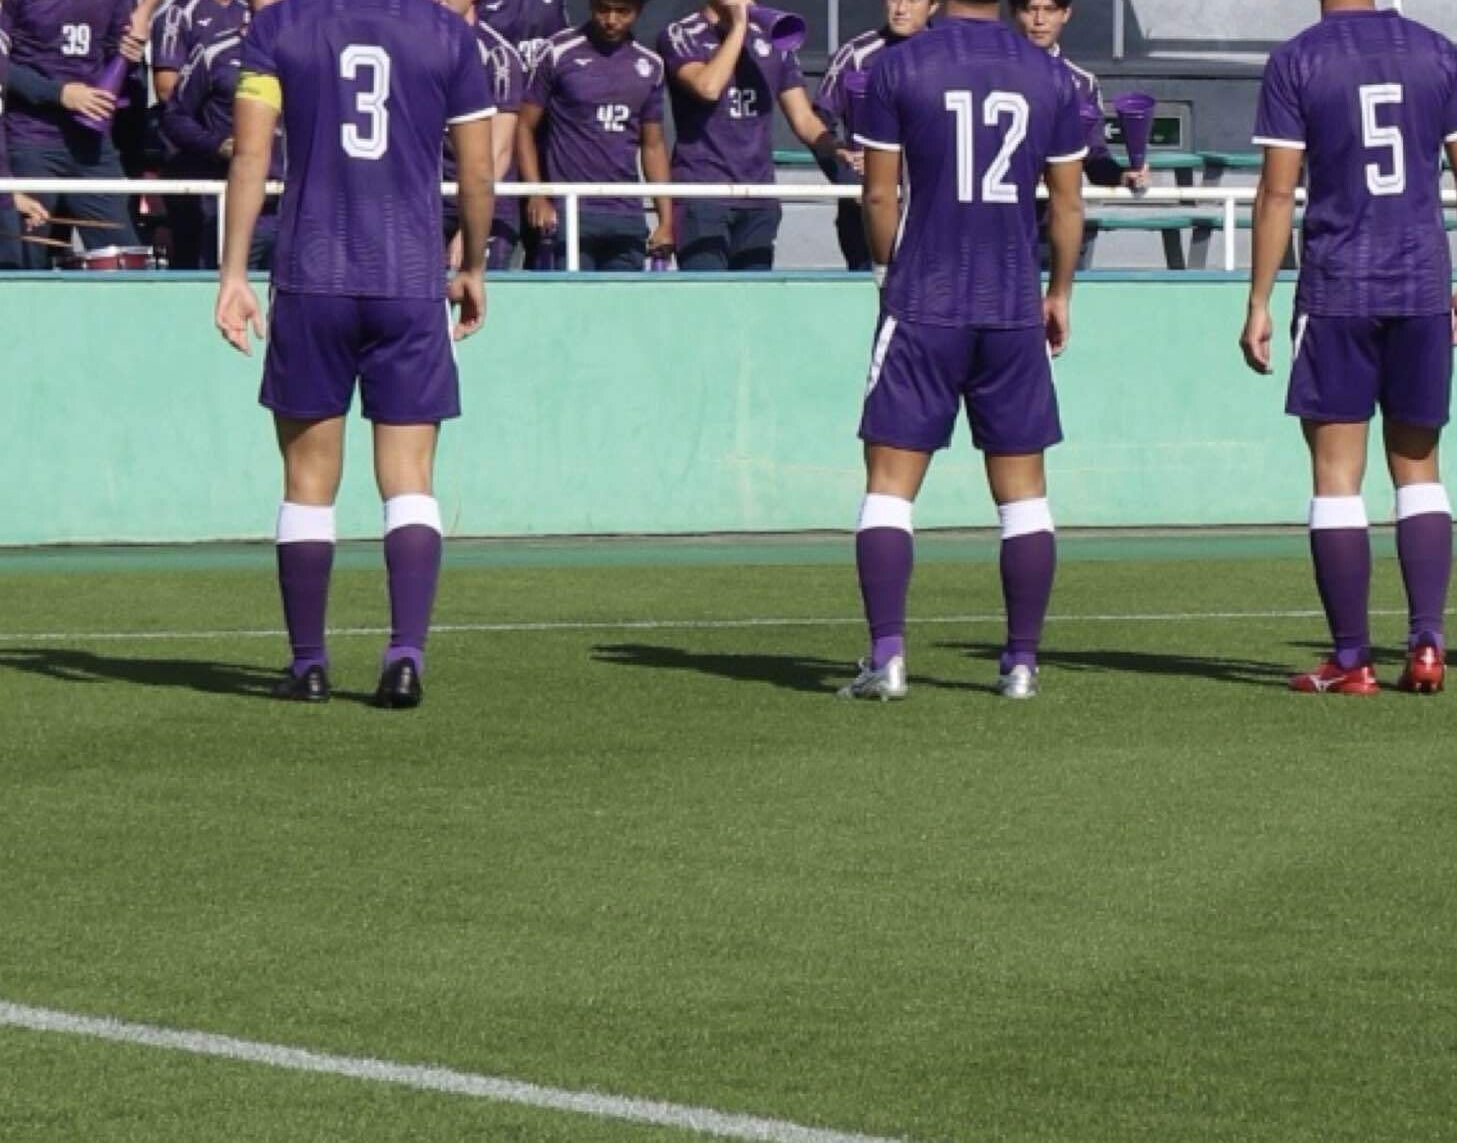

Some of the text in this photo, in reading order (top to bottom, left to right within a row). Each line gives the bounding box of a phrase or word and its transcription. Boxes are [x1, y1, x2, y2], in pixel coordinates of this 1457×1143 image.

[61, 22, 92, 56] 39
[339, 44, 391, 160] 3
[596, 104, 630, 132] 42
[727, 86, 758, 119] 32
[944, 89, 1030, 204] 12
[1358, 84, 1406, 196] 5
